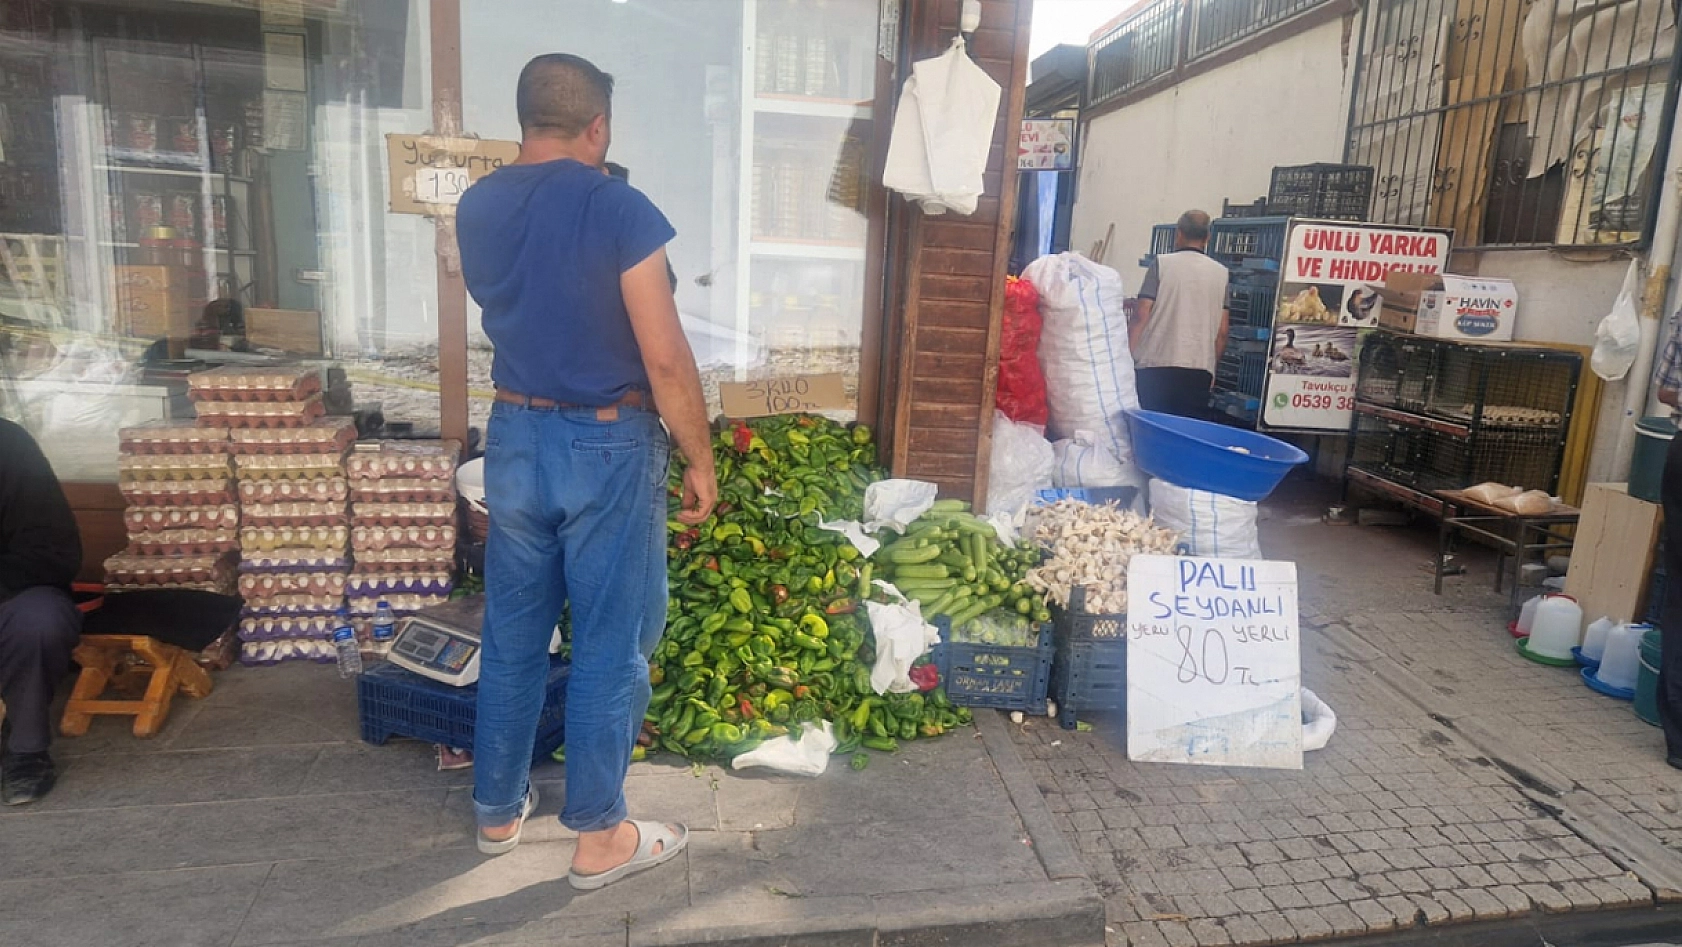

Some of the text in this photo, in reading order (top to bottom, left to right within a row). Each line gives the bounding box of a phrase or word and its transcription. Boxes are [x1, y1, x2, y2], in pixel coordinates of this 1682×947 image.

[428, 172, 469, 198] 130
[1303, 229, 1438, 258] ÜNLÜ YARKA
[1297, 257, 1325, 278] VE
[1301, 380, 1348, 395] Tavukçu
[766, 395, 800, 413] 100
[1292, 395, 1332, 409] 0539
[1149, 591, 1283, 621] SEYDANLI
[1177, 625, 1228, 685] 80
